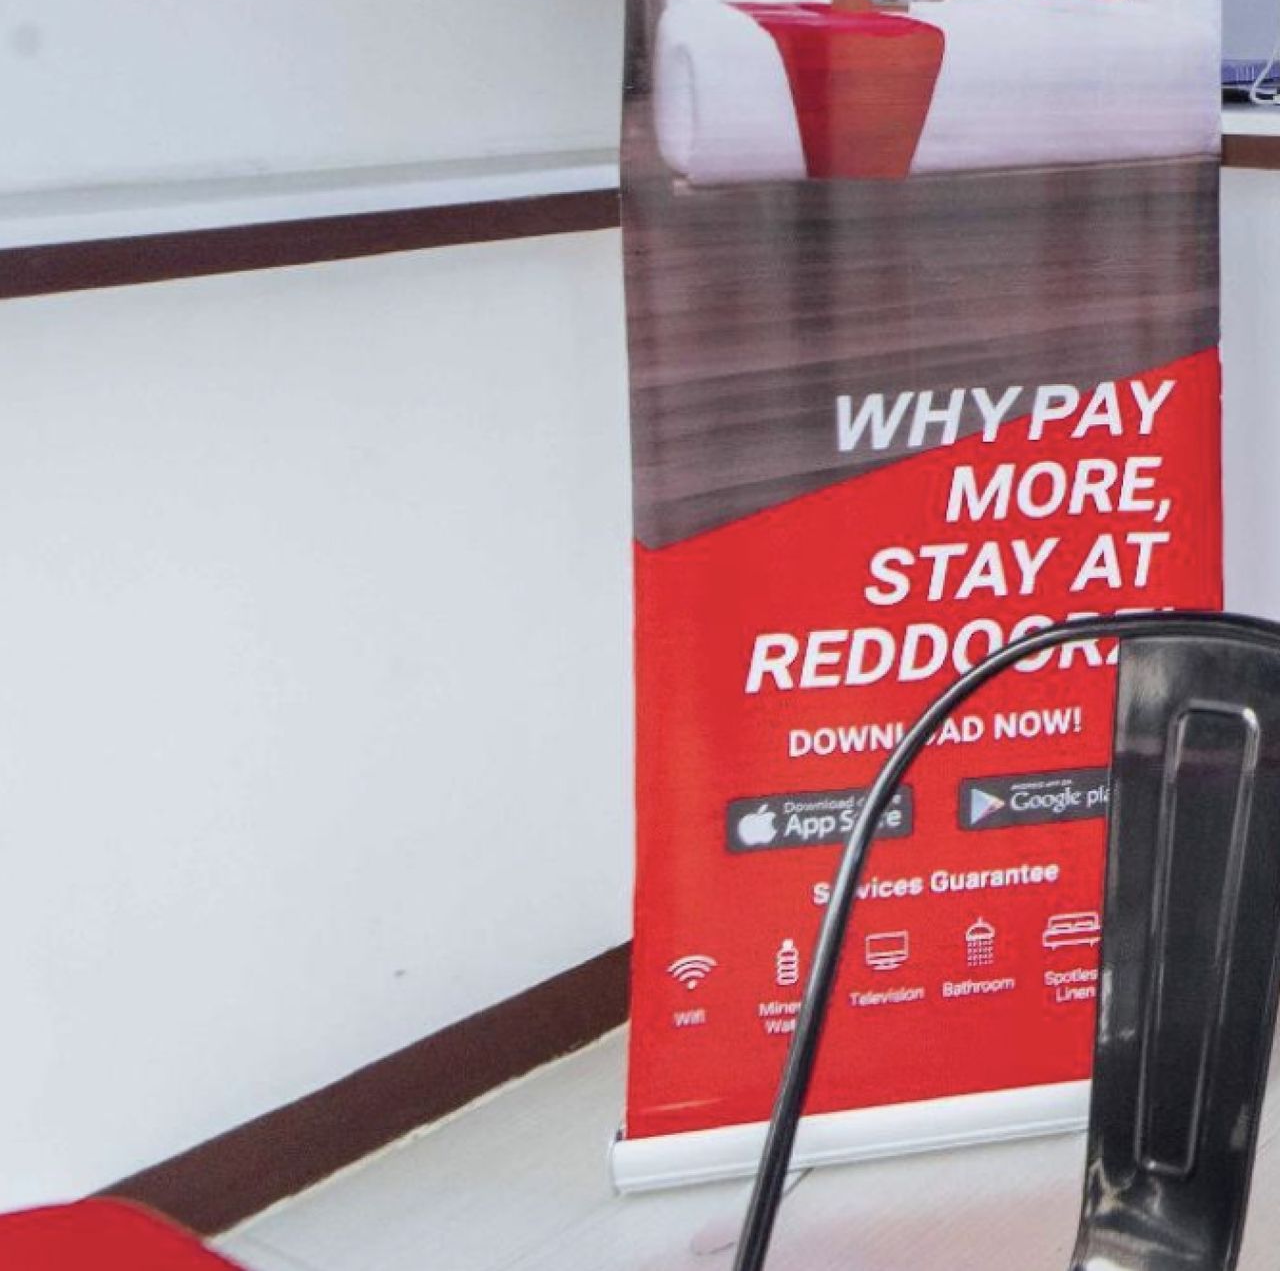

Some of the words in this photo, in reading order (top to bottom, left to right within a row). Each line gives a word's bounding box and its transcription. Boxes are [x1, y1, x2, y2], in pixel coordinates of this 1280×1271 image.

[837, 386, 1022, 451] WHY
[1027, 379, 1178, 440] PAY
[946, 456, 1173, 523] MORE,
[864, 537, 1059, 606] STAY
[1071, 531, 1170, 592] AT
[745, 606, 1175, 694] REDDOOR
[788, 715, 984, 757] DOWNLAD
[994, 706, 1082, 742] NOW!
[784, 795, 855, 813] Download
[1010, 787, 1081, 813] Google
[784, 813, 836, 840] App
[812, 876, 924, 905] Svices
[929, 863, 1059, 893] Guarantee
[942, 976, 1015, 998] Bathroom
[1044, 967, 1097, 987] Spotles
[849, 985, 925, 1008] Television
[1055, 984, 1096, 1003] Linen
[674, 1009, 707, 1027] Wifi
[758, 1000, 802, 1018] Mine
[765, 1018, 797, 1034] Wat
